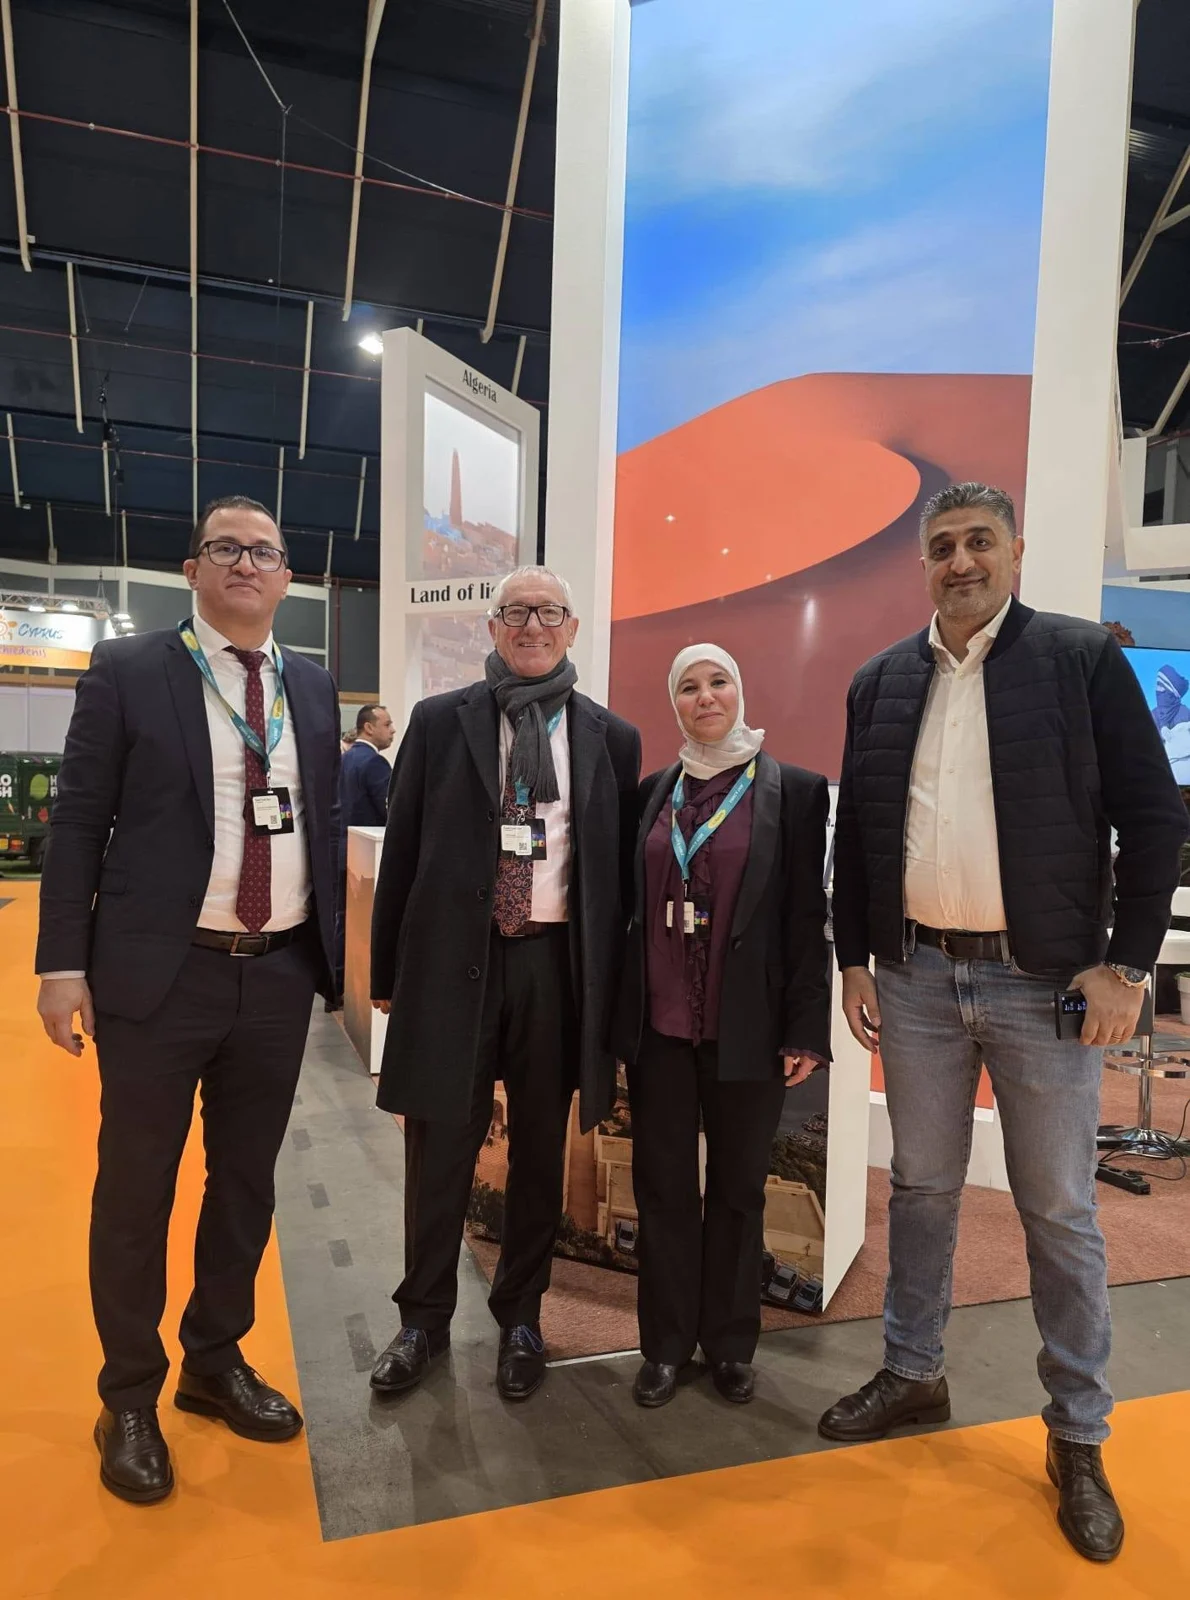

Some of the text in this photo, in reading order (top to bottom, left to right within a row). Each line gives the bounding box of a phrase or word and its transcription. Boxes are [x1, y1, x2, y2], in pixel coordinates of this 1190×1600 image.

[463, 369, 497, 403] Algeria
[411, 585, 450, 603] Land
[457, 583, 474, 601] of
